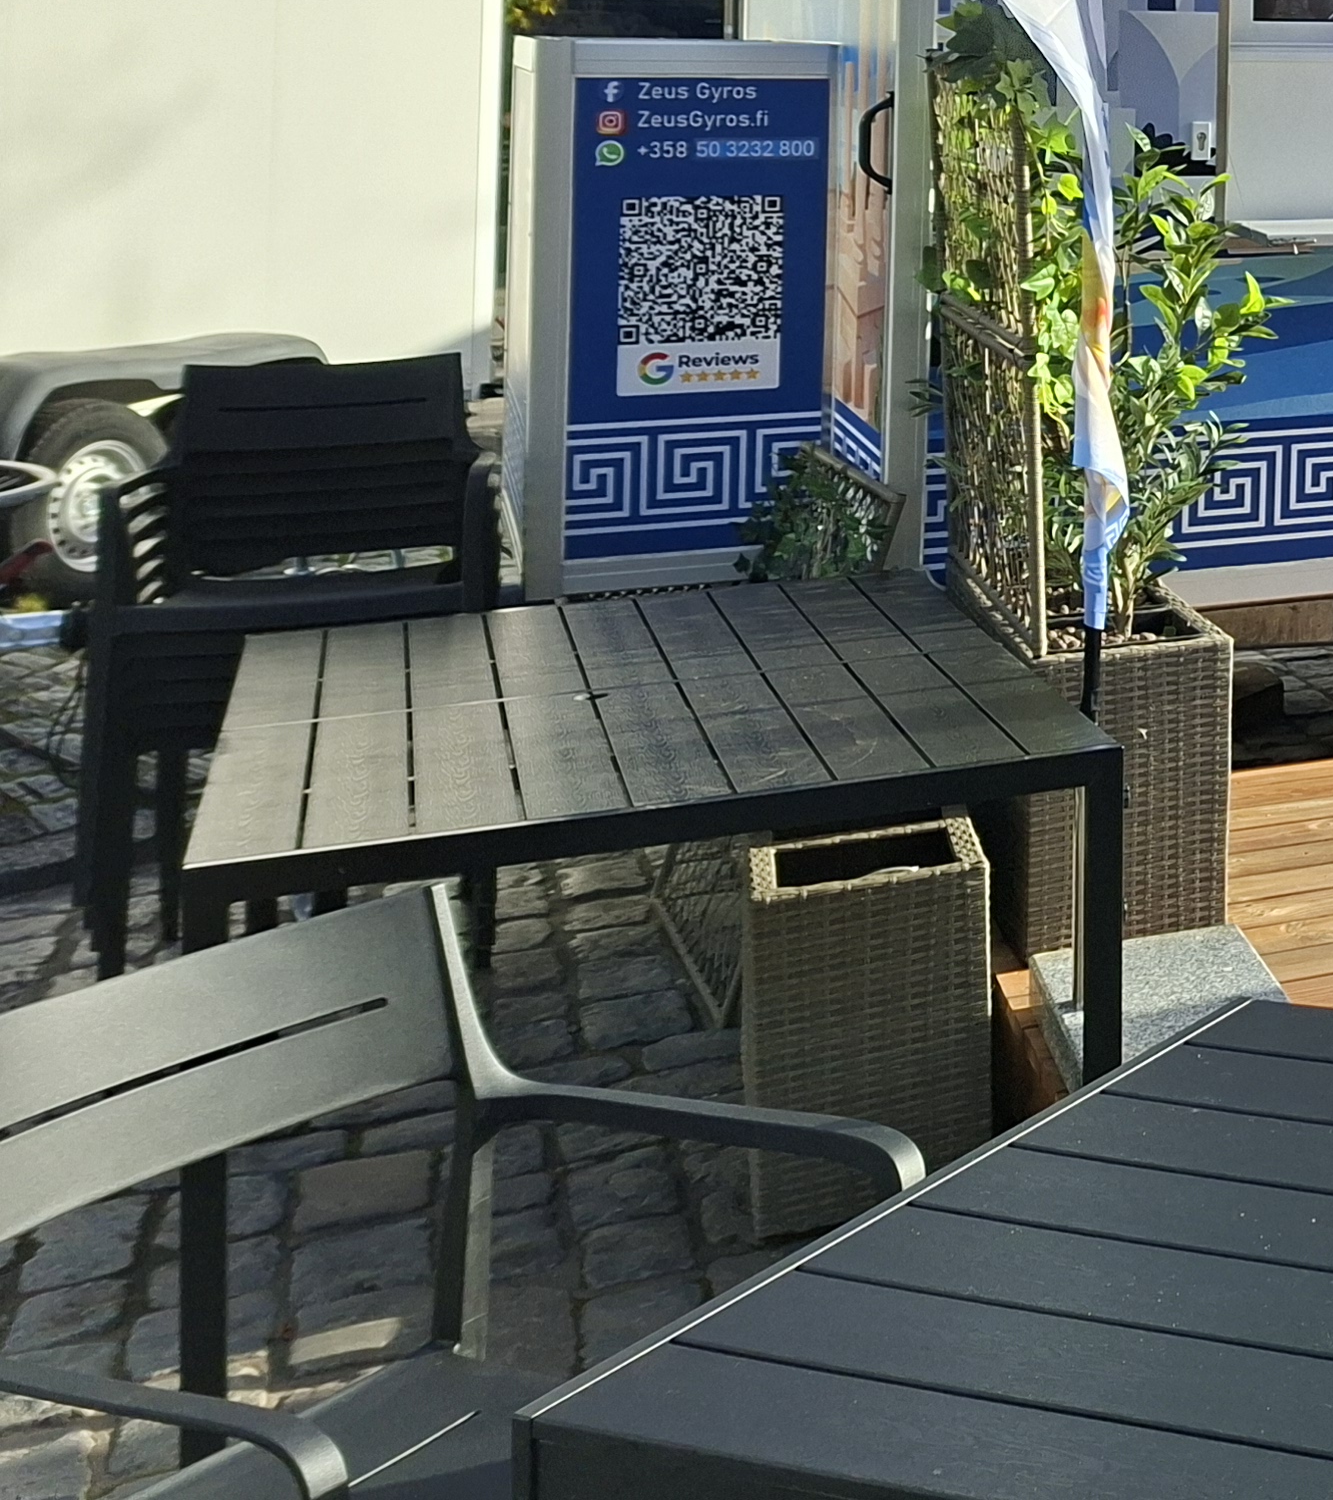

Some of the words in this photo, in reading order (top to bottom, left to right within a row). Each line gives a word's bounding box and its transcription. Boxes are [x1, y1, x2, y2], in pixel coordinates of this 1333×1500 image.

[637, 81, 689, 100] Zeus
[696, 81, 757, 103] Gyros
[636, 109, 770, 131] ZeusGyros.fi
[636, 140, 688, 158] +358
[696, 140, 721, 157] 50
[725, 139, 774, 157] 3232
[778, 139, 815, 157] 800
[678, 351, 760, 368] Reviews
